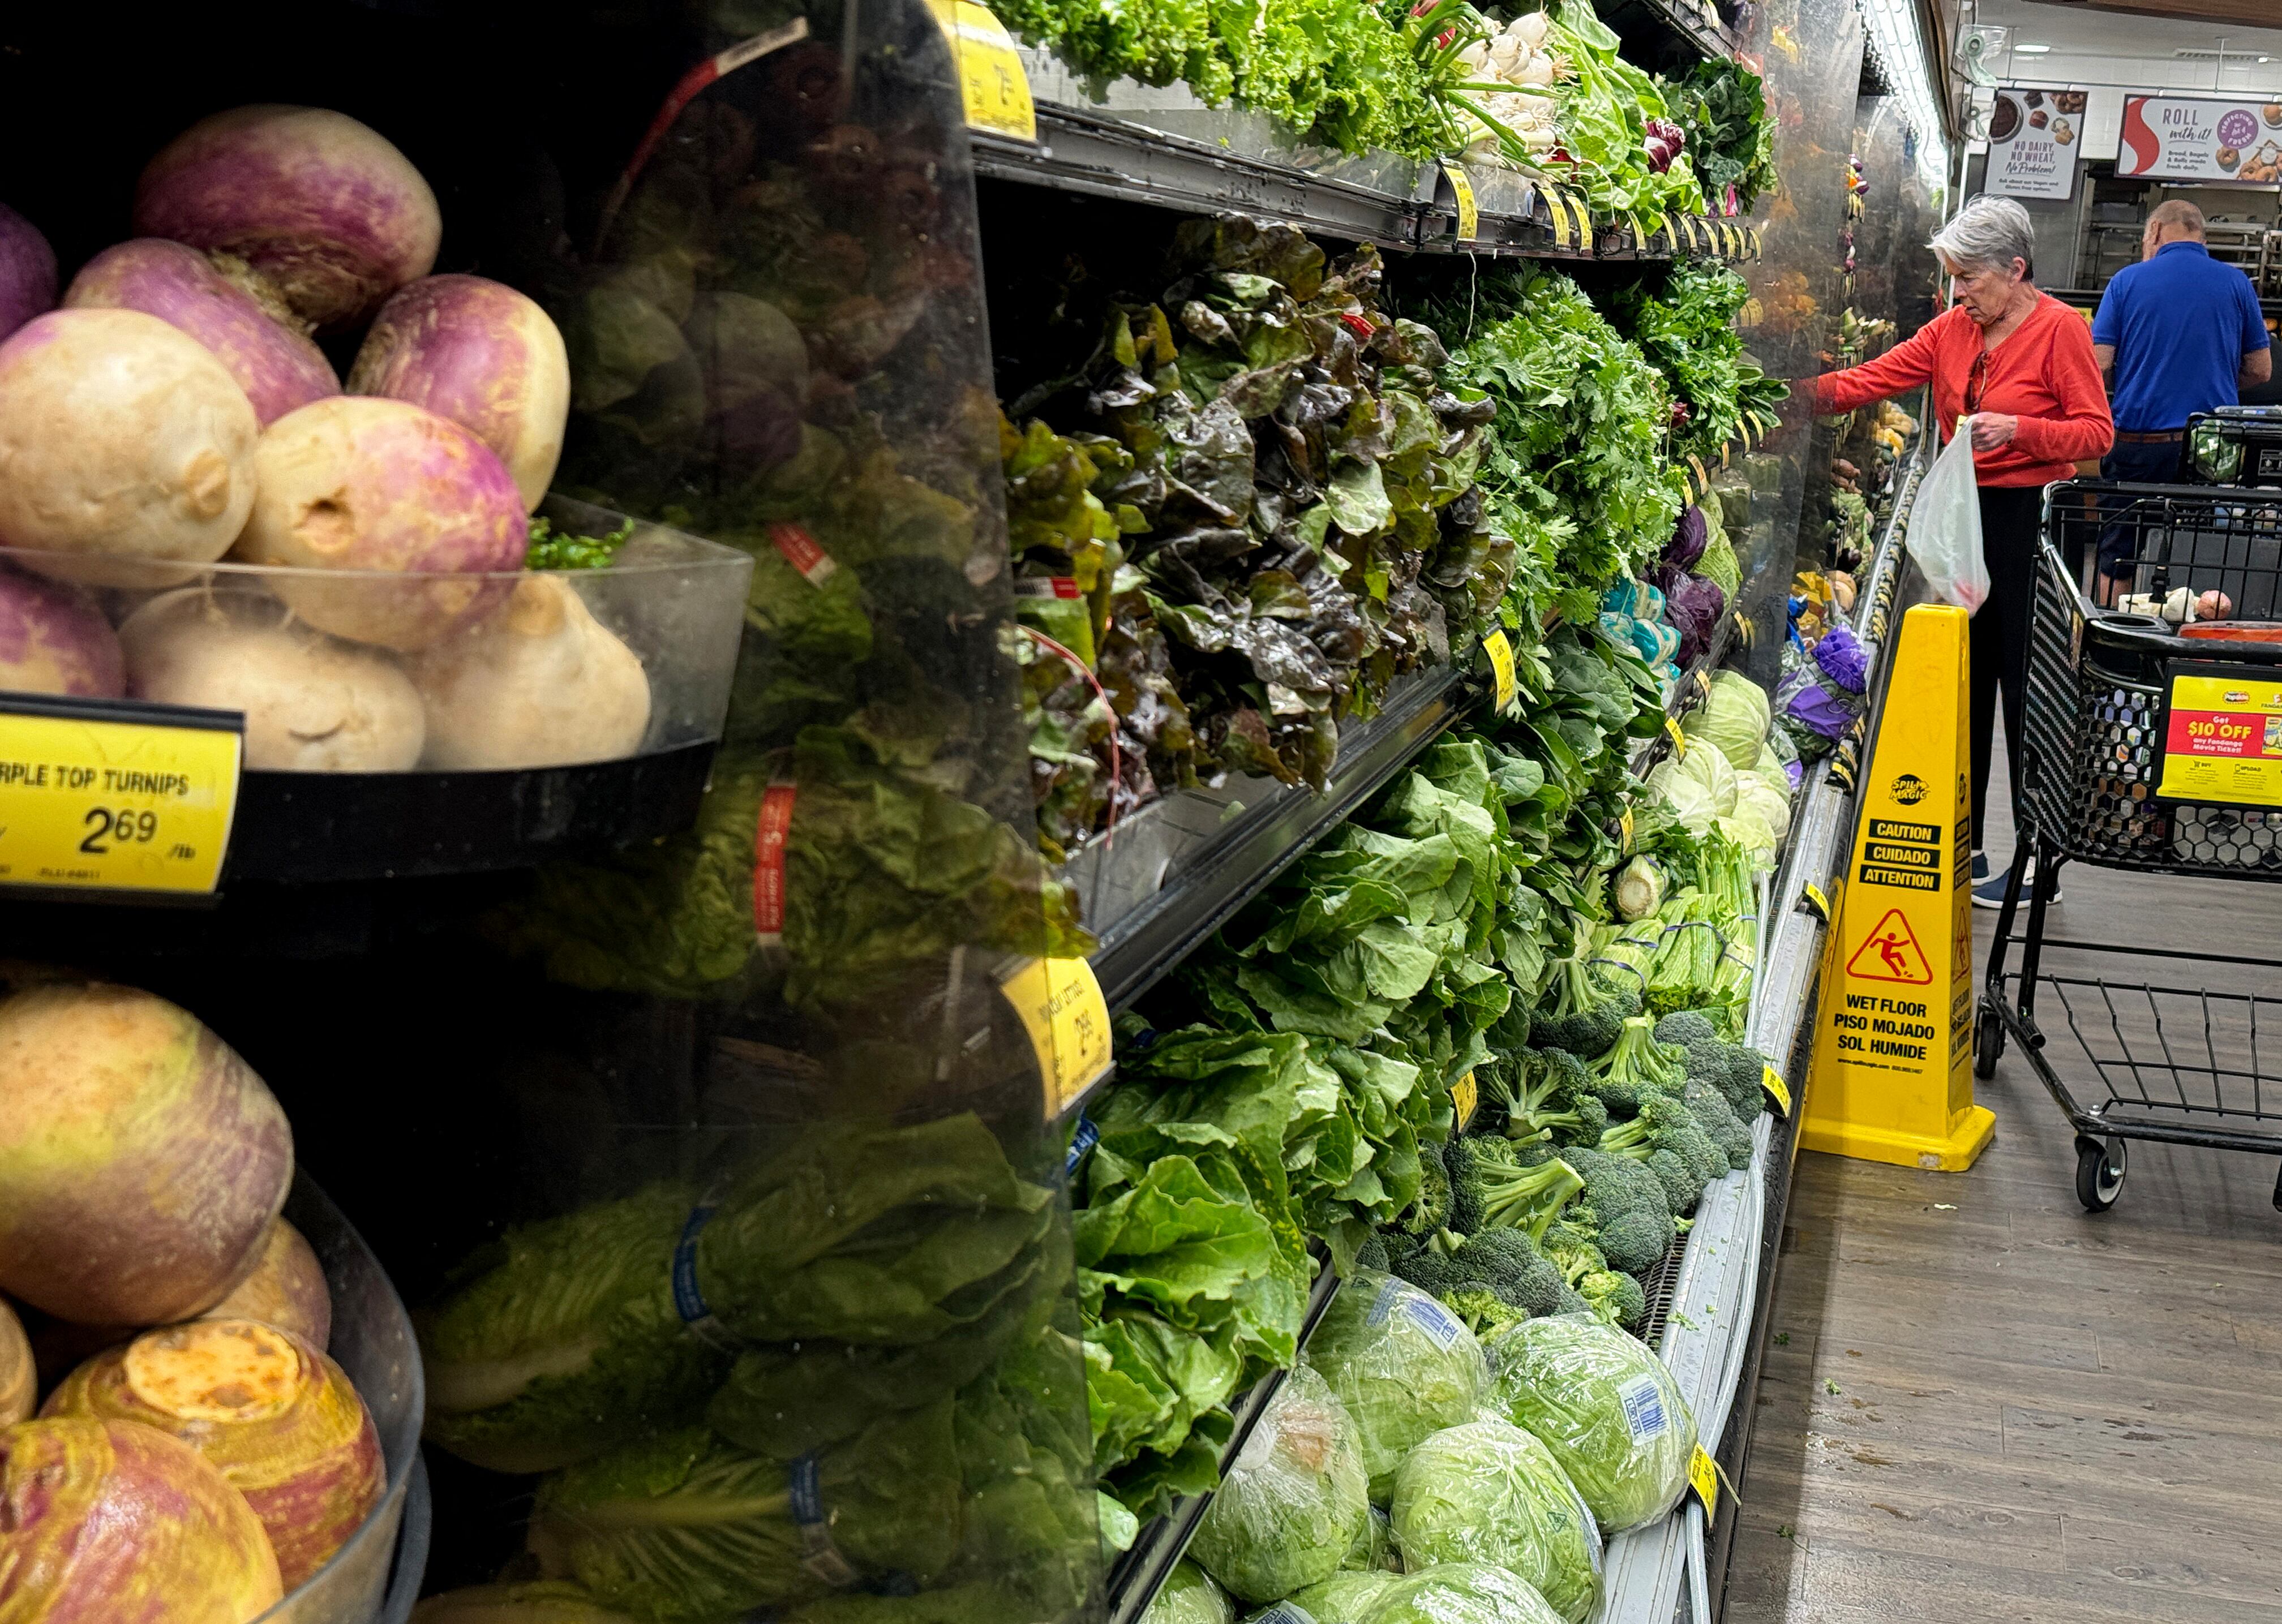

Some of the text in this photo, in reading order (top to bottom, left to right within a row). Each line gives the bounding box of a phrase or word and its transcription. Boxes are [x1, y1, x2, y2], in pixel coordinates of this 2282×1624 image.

[2163, 109, 2198, 126] ROLL
[2169, 127, 2212, 140] with it!
[2014, 141, 2026, 151] NO
[2011, 151, 2055, 164] NO WHEAT,
[2005, 162, 2056, 174] No Problem!
[2212, 715, 2229, 724] Get
[2187, 721, 2252, 740] $10 OFF
[57, 766, 97, 788] TOP
[104, 768, 190, 796] TURNIPS
[1890, 790, 1928, 799] MAGIC
[1877, 823, 1932, 841] CAUTION
[1873, 847, 1931, 865] CUIDADO
[1864, 868, 1934, 888] ATTENTION
[1847, 994, 1927, 1018] WET FLOOR
[1834, 1013, 1935, 1040] PISO MOJADO
[1838, 1034, 1927, 1060] SOL HUMIDE
